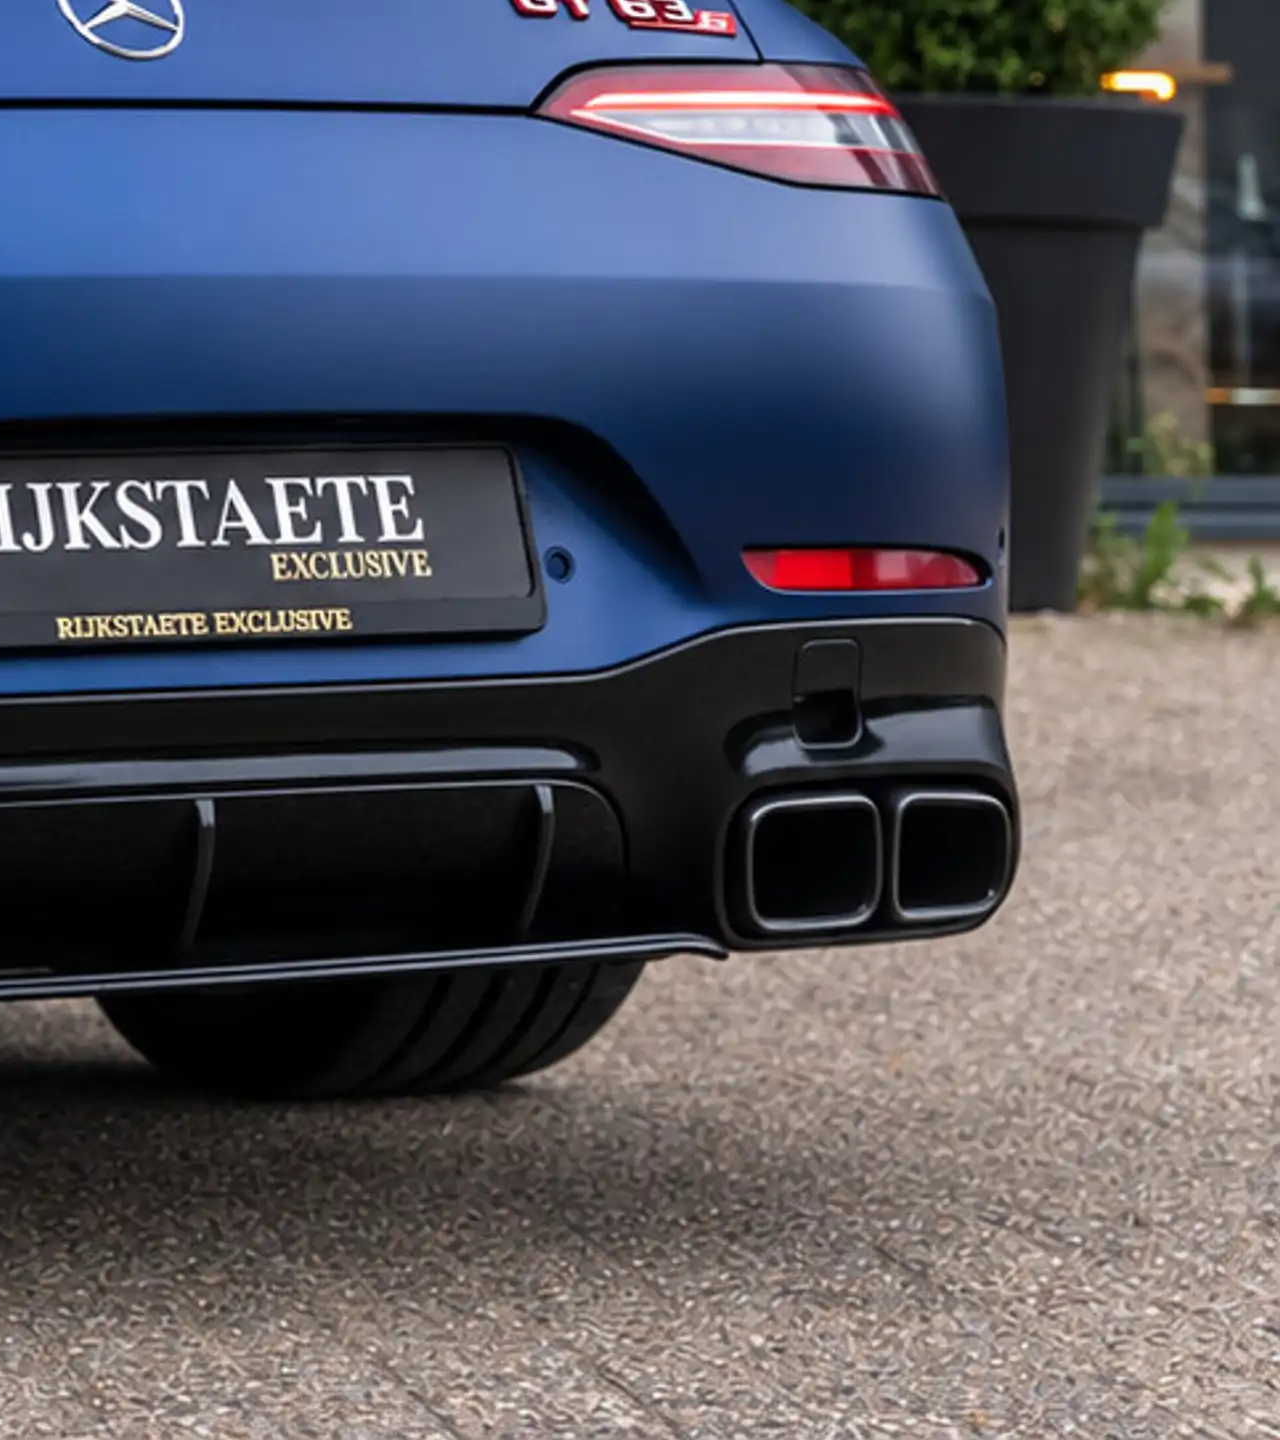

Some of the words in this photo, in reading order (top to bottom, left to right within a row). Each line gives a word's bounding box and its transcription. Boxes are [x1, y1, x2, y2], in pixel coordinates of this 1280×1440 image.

[271, 550, 432, 581] EXCLUSIVE
[56, 613, 208, 639] RIJKSTAETE
[215, 608, 353, 634] EXCLUSIVE
